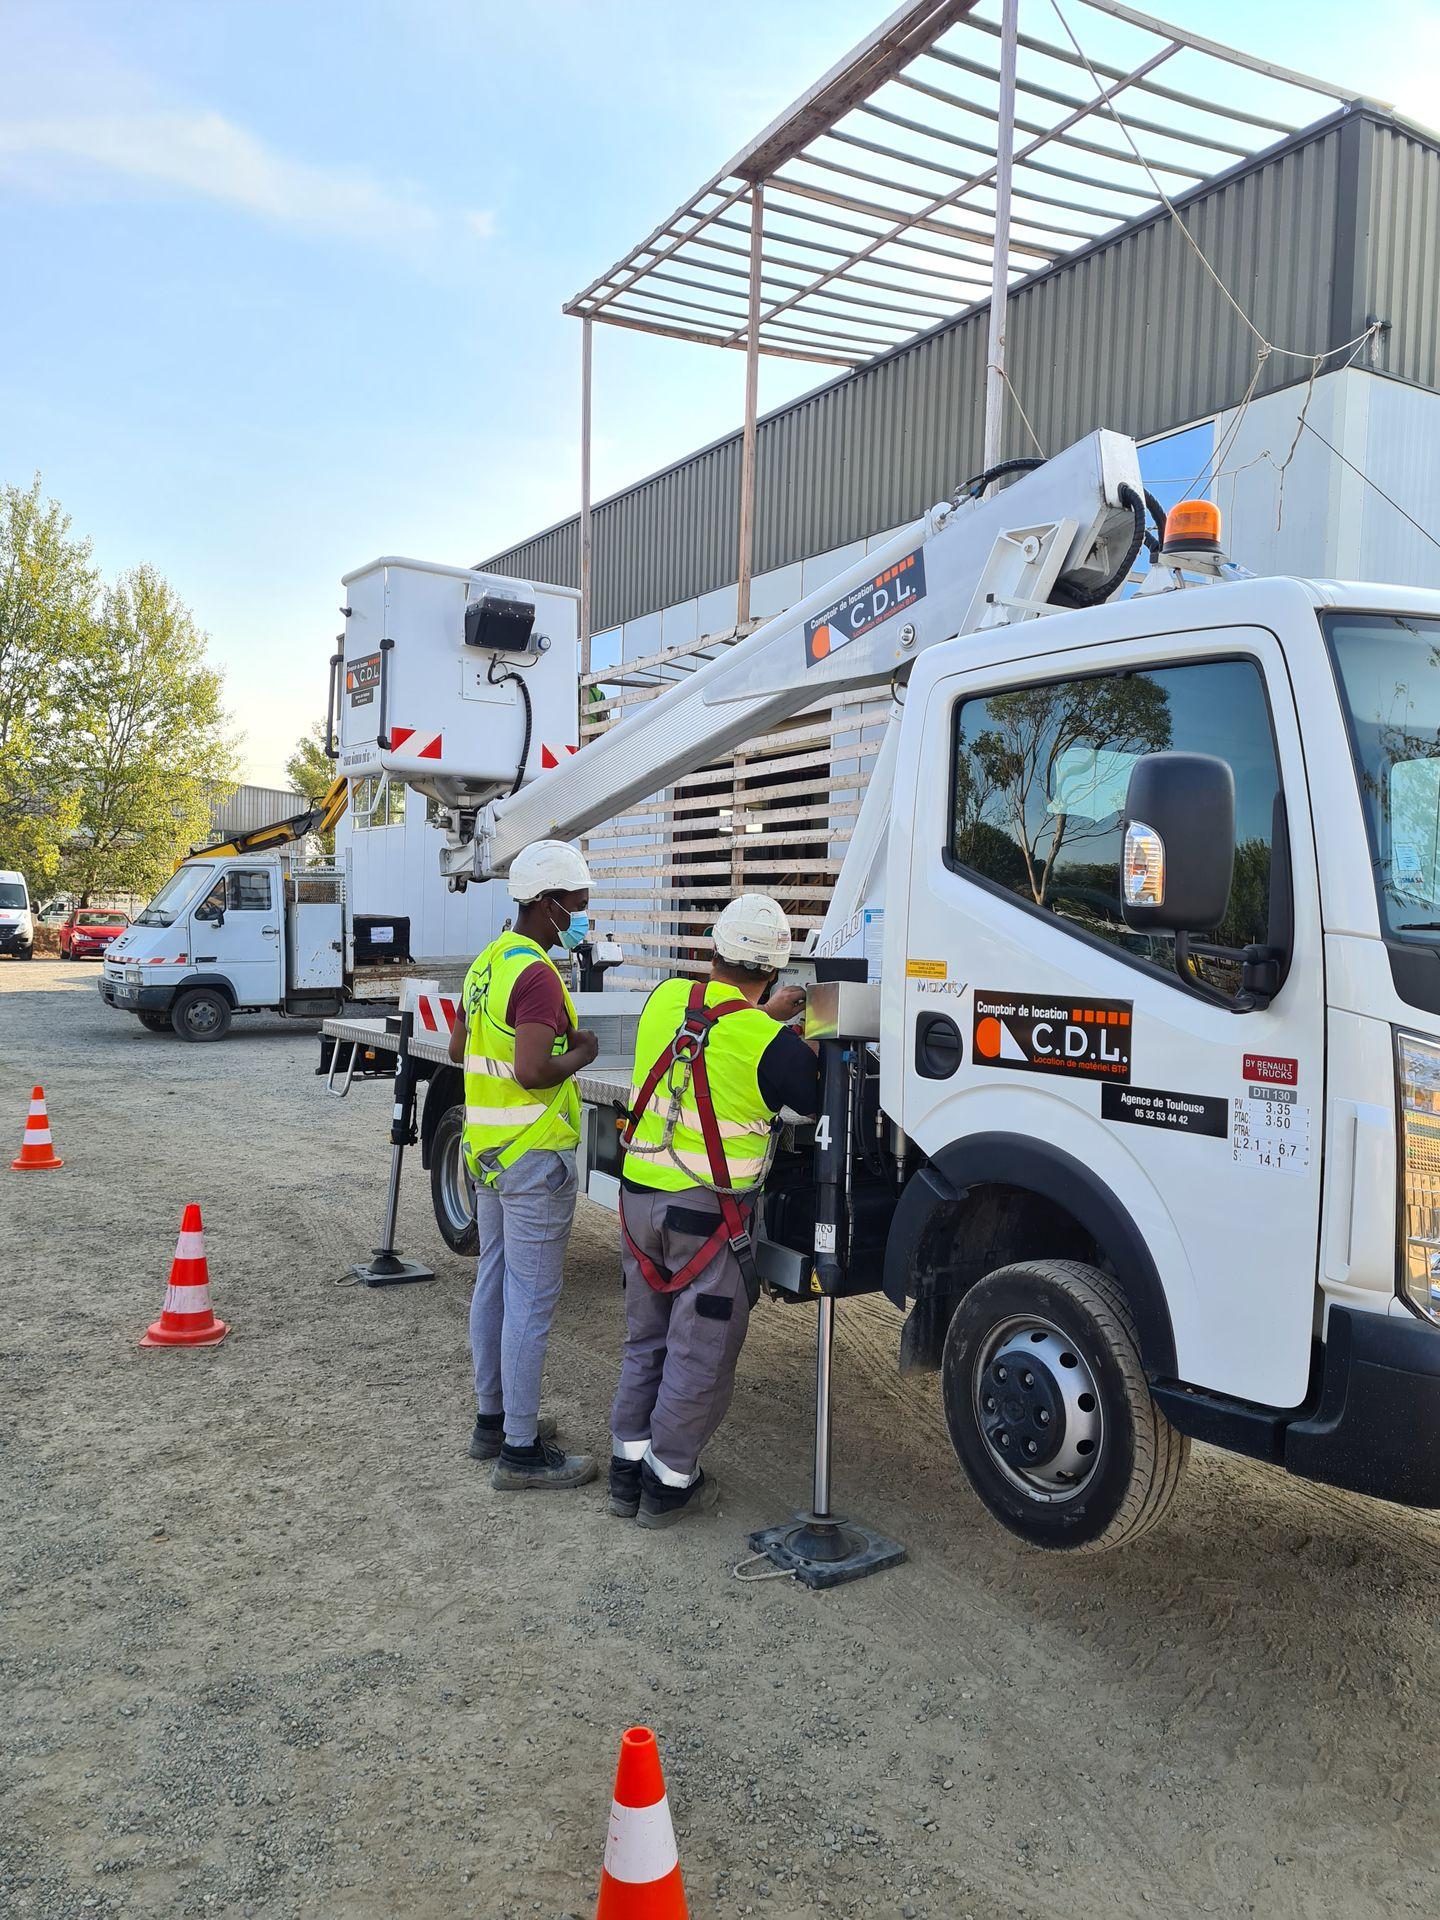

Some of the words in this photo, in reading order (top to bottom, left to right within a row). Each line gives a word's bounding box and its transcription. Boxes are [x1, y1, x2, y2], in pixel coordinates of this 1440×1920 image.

[810, 606, 838, 629] Comptoir
[839, 600, 847, 611] de
[848, 584, 874, 605] location
[850, 577, 916, 629] C.D.L.
[917, 979, 968, 998] Maxity
[977, 1001, 1016, 1018] Comptoir
[1018, 1004, 1029, 1017] de
[1032, 1006, 1068, 1020] location
[1032, 1022, 1128, 1063] C.D.L.
[1033, 1055, 1065, 1067] Location
[1067, 1059, 1077, 1068] de
[1078, 1061, 1110, 1072] matériel
[1112, 1064, 1128, 1074] BTP
[1245, 1059, 1255, 1067] BY
[1257, 1061, 1293, 1072] RENAULT
[1258, 1069, 1293, 1080] TRUCKS
[1120, 1092, 1151, 1106] Agence
[1153, 1097, 1164, 1108] de
[1165, 1098, 1205, 1114] Toulouse
[1273, 1090, 1290, 1101] 130
[1135, 1108, 1144, 1118] 05
[1145, 1110, 1155, 1120] 32
[1156, 1111, 1166, 1121] 53
[1167, 1113, 1177, 1123] 44
[1178, 1115, 1188, 1125] 42
[814, 1114, 833, 1151] 4
